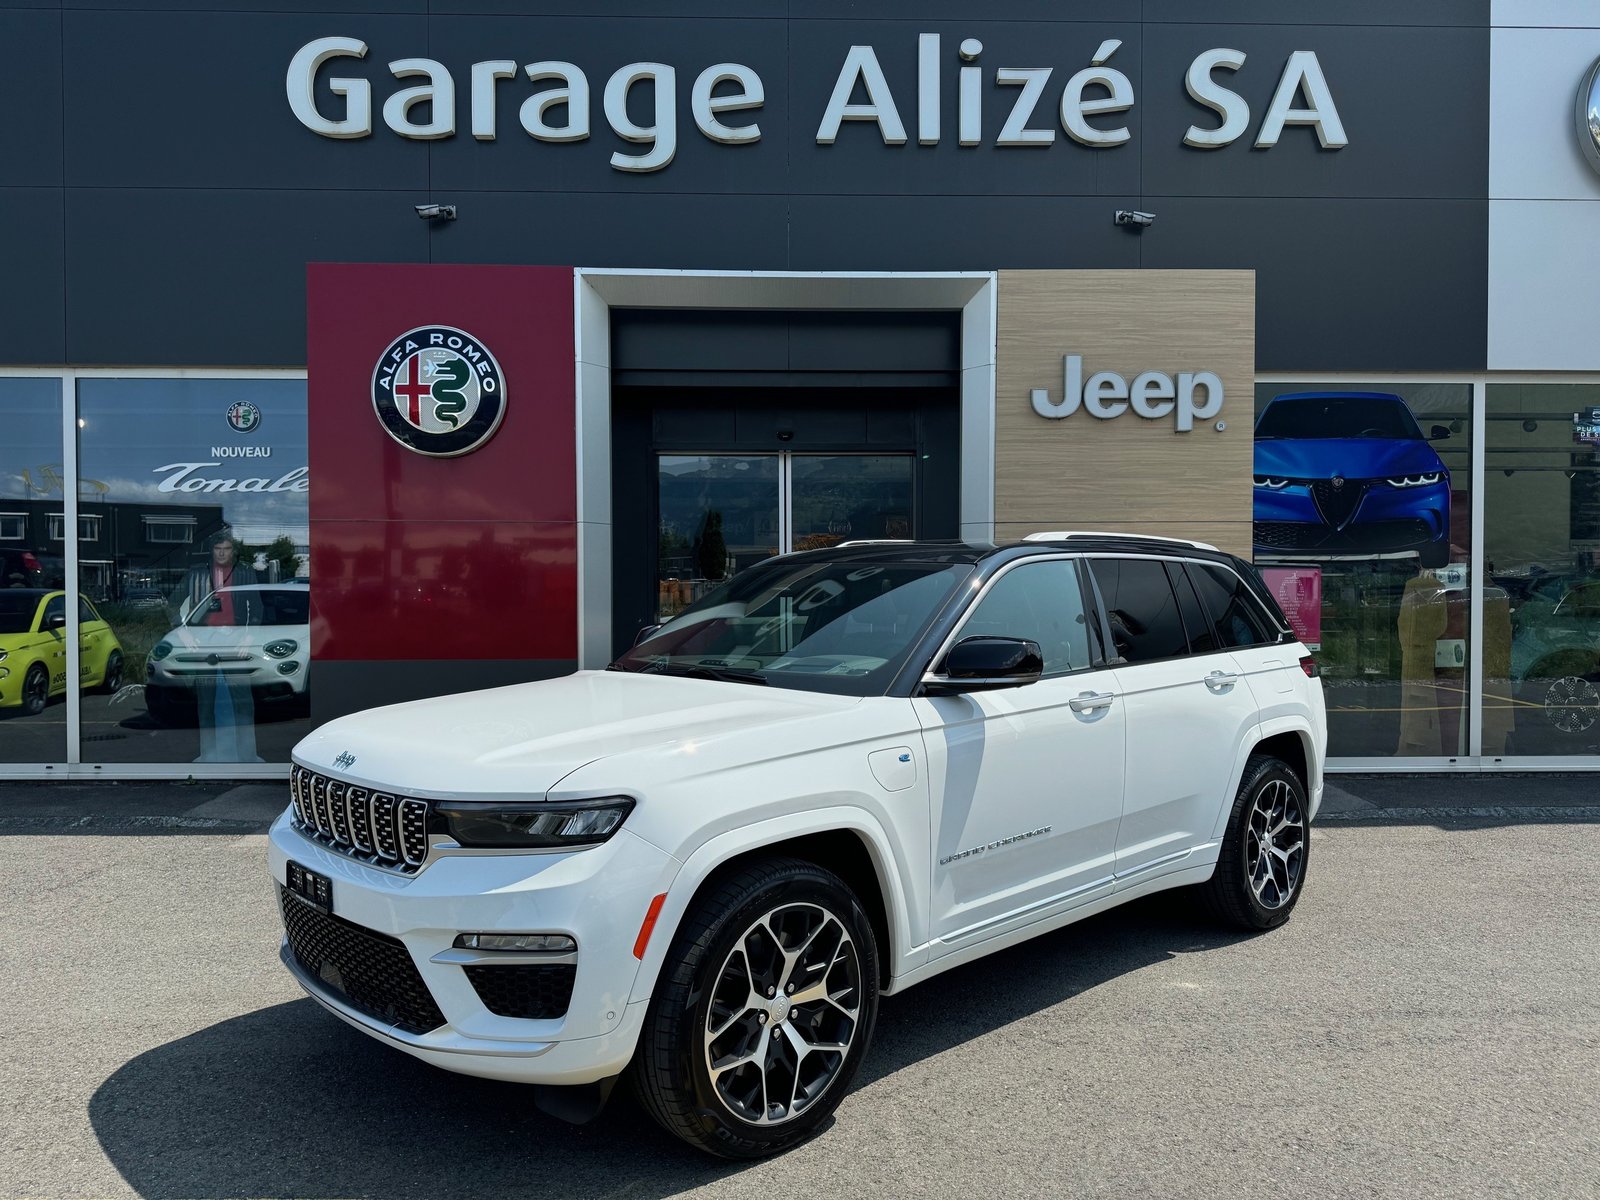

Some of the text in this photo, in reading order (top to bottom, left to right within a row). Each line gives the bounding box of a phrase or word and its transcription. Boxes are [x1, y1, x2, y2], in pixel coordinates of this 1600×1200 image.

[286, 32, 1349, 173] Garage Alizé SA
[380, 333, 496, 392] ALFA ROMEO
[1029, 353, 1225, 433] Jeep
[211, 446, 271, 458] NOUVEAU
[940, 825, 1053, 866] GRAND CHEROKEE
